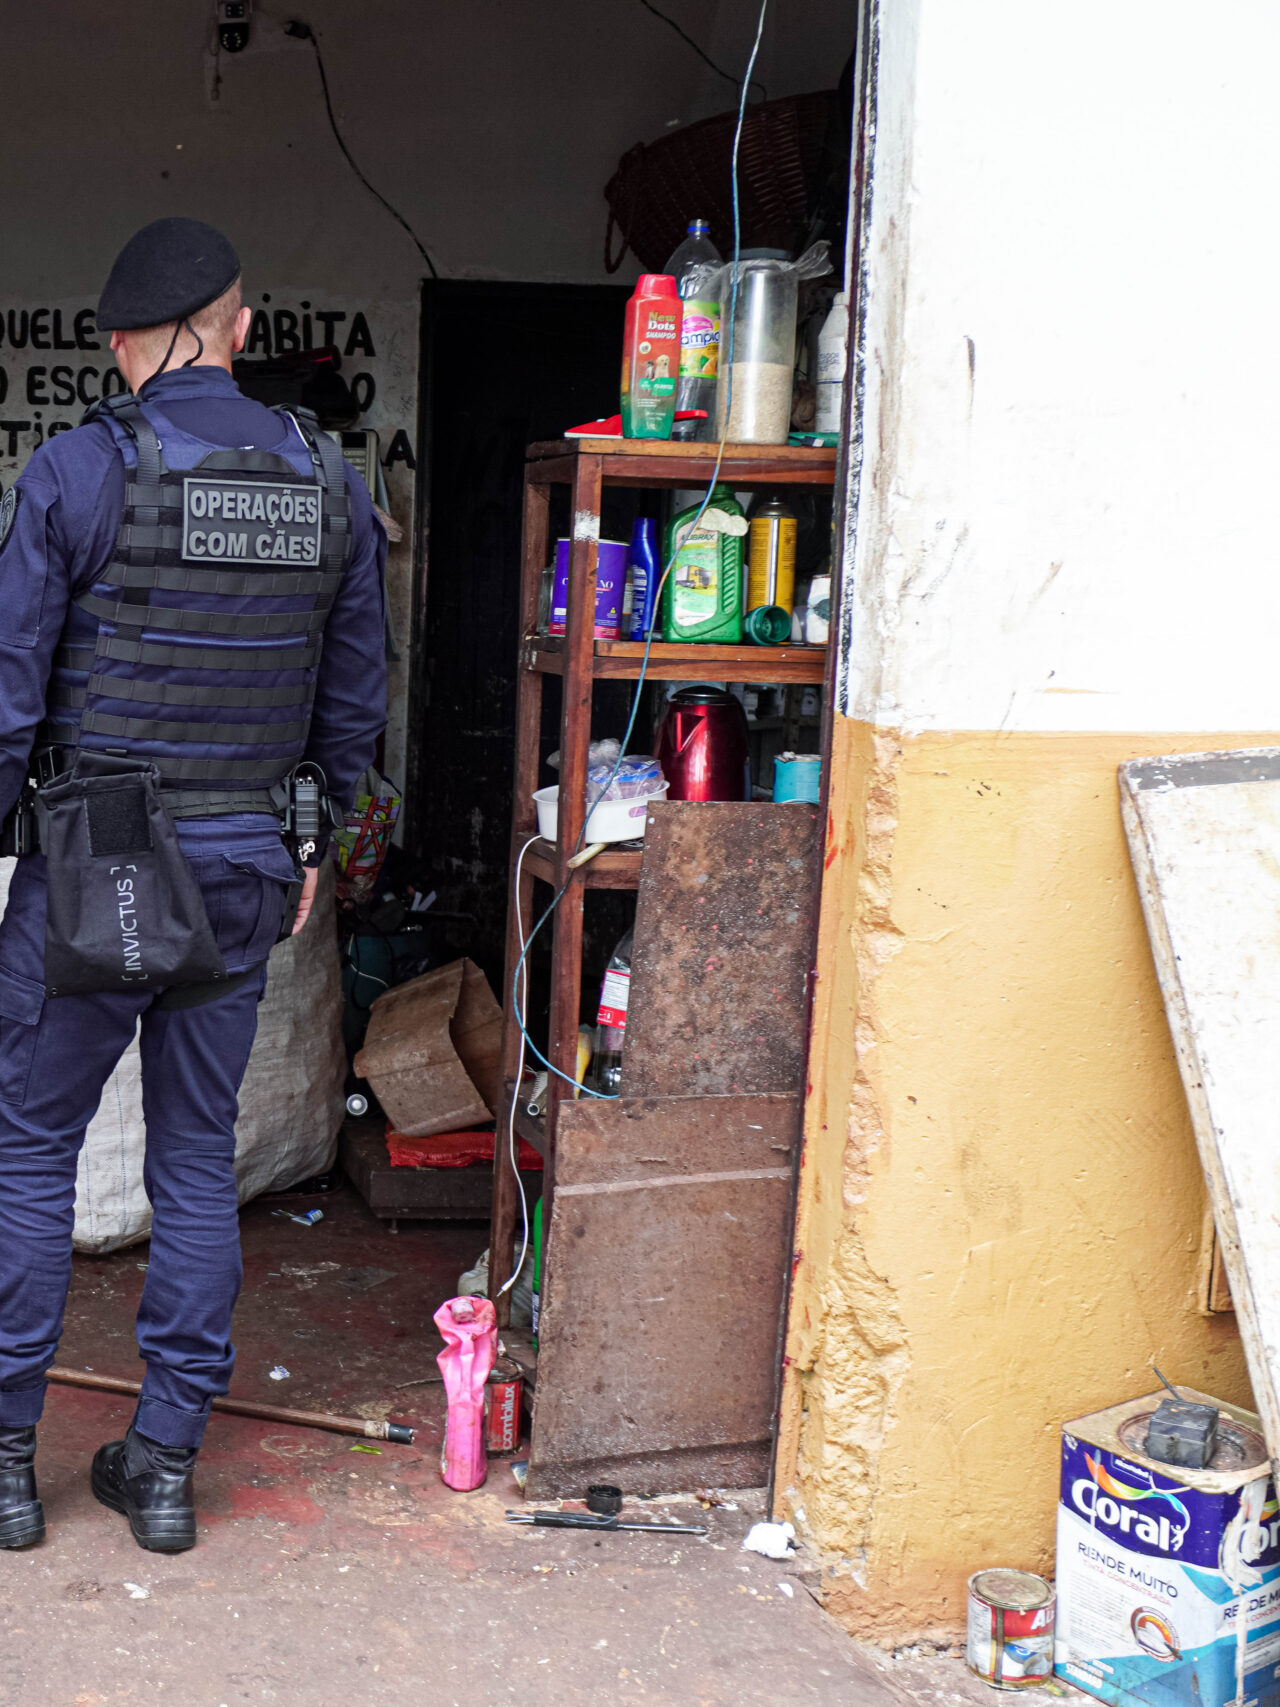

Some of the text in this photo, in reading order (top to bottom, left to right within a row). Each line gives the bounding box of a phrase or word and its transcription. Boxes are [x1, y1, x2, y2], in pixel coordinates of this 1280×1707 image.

[645, 331, 677, 340] SHAMPOO
[647, 320, 675, 331] Dots
[649, 312, 676, 322] New
[26, 365, 131, 406] ESCO
[190, 489, 318, 529] OPERAÇÕES
[188, 529, 316, 561] COM CÃES
[117, 878, 142, 971] INVICTUS
[500, 1385, 515, 1450] combilux
[1071, 1478, 1170, 1551] Coral
[1078, 1542, 1178, 1598] RENDE MUITO
[1223, 1595, 1267, 1621] REDE
